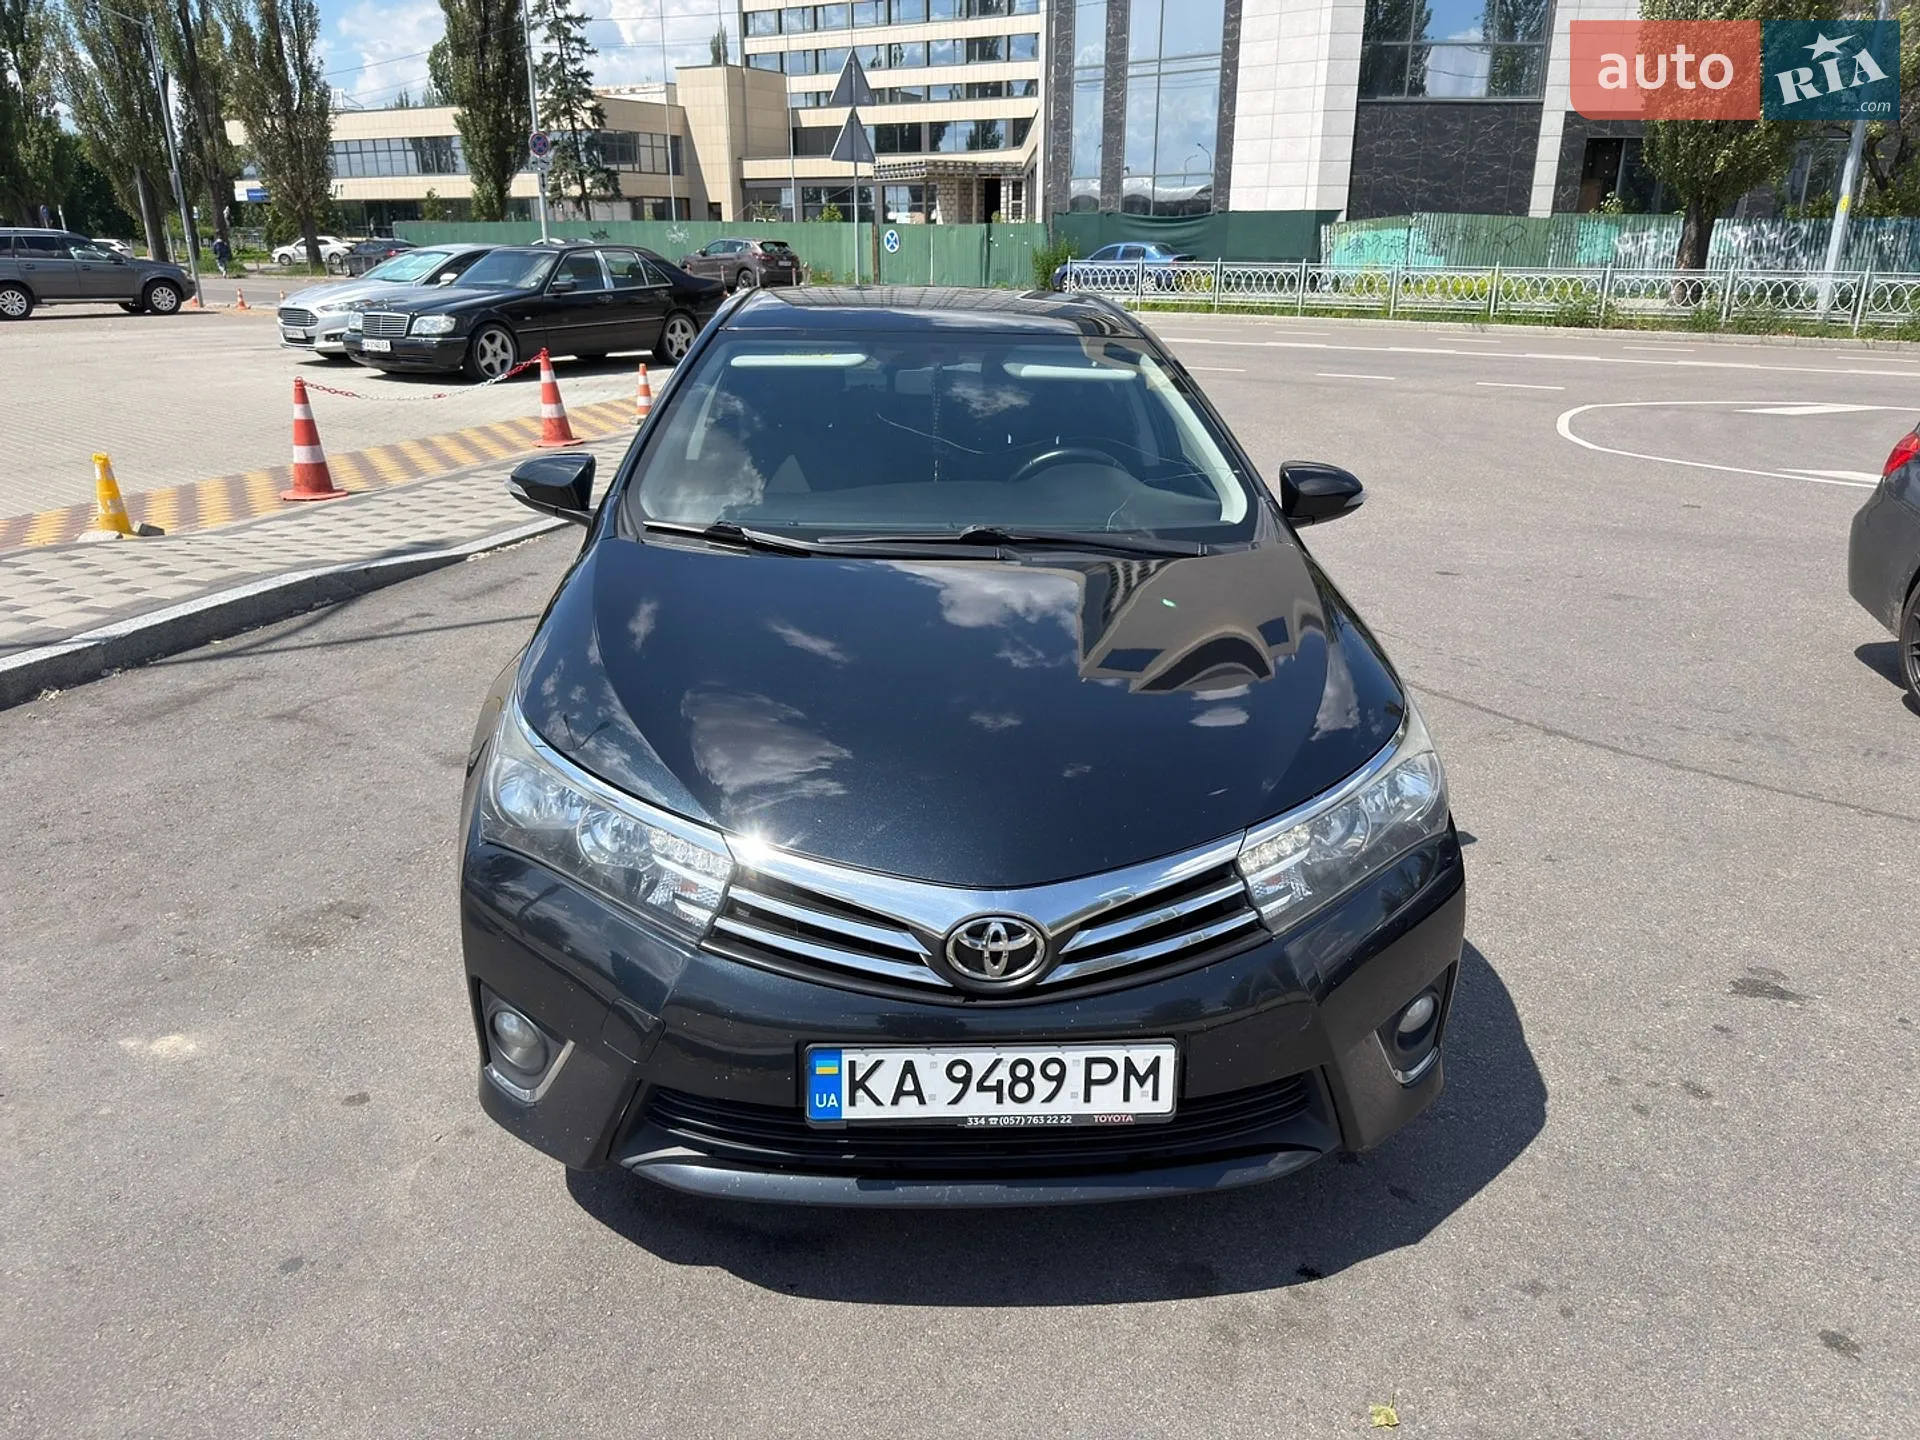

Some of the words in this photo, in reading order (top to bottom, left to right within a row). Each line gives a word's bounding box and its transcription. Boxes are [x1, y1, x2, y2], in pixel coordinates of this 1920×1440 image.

[848, 1059, 927, 1107] KA
[945, 1056, 1067, 1106] 9489
[1083, 1055, 1161, 1104] PM
[815, 1093, 839, 1108] UA
[967, 1117, 986, 1126] 334
[1027, 1115, 1045, 1124] 763
[1046, 1115, 1059, 1124] 22
[1060, 1115, 1073, 1124] 22
[1093, 1114, 1134, 1124] TOYOTA
